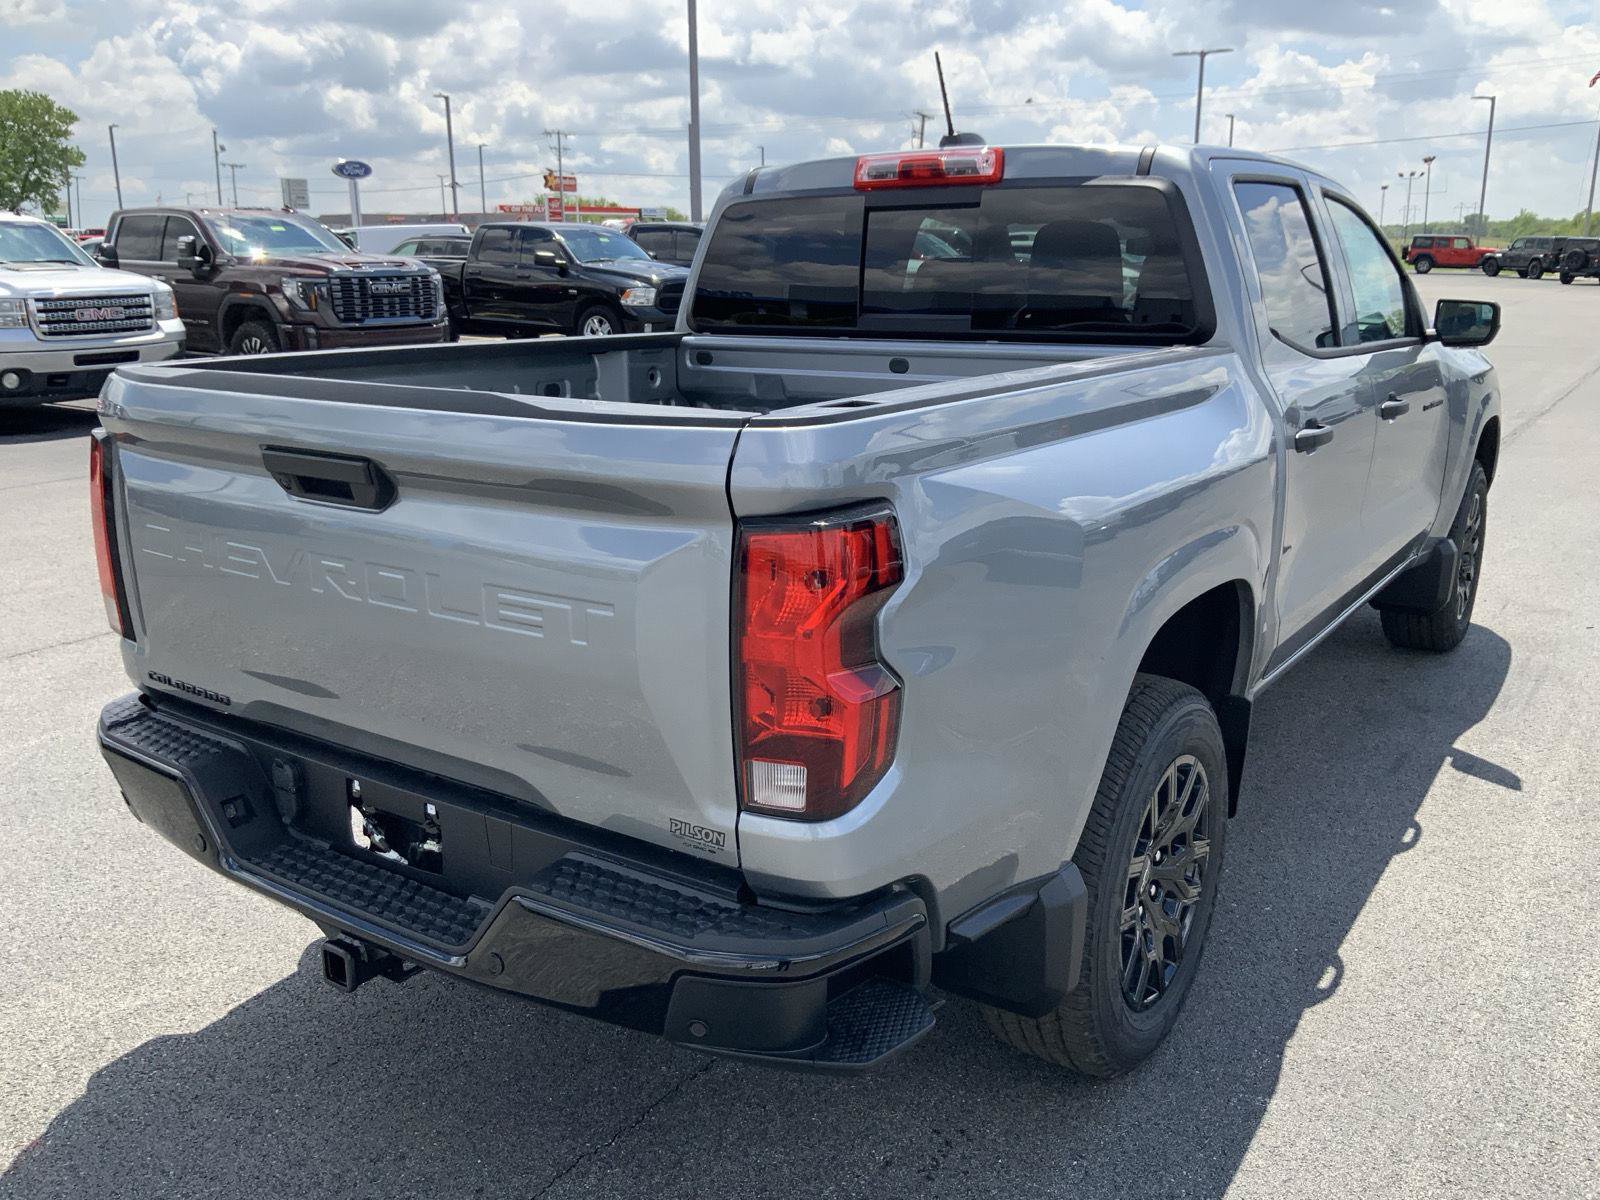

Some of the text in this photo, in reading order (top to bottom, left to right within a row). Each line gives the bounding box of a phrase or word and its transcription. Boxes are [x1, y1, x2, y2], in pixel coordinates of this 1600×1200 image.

[342, 164, 366, 176] Ford
[534, 206, 546, 214] FLY
[371, 283, 412, 294] GMC
[75, 306, 126, 322] GMC
[142, 524, 615, 647] CHEVROLET
[147, 670, 232, 706] COLORADO
[669, 818, 726, 847] PILSON
